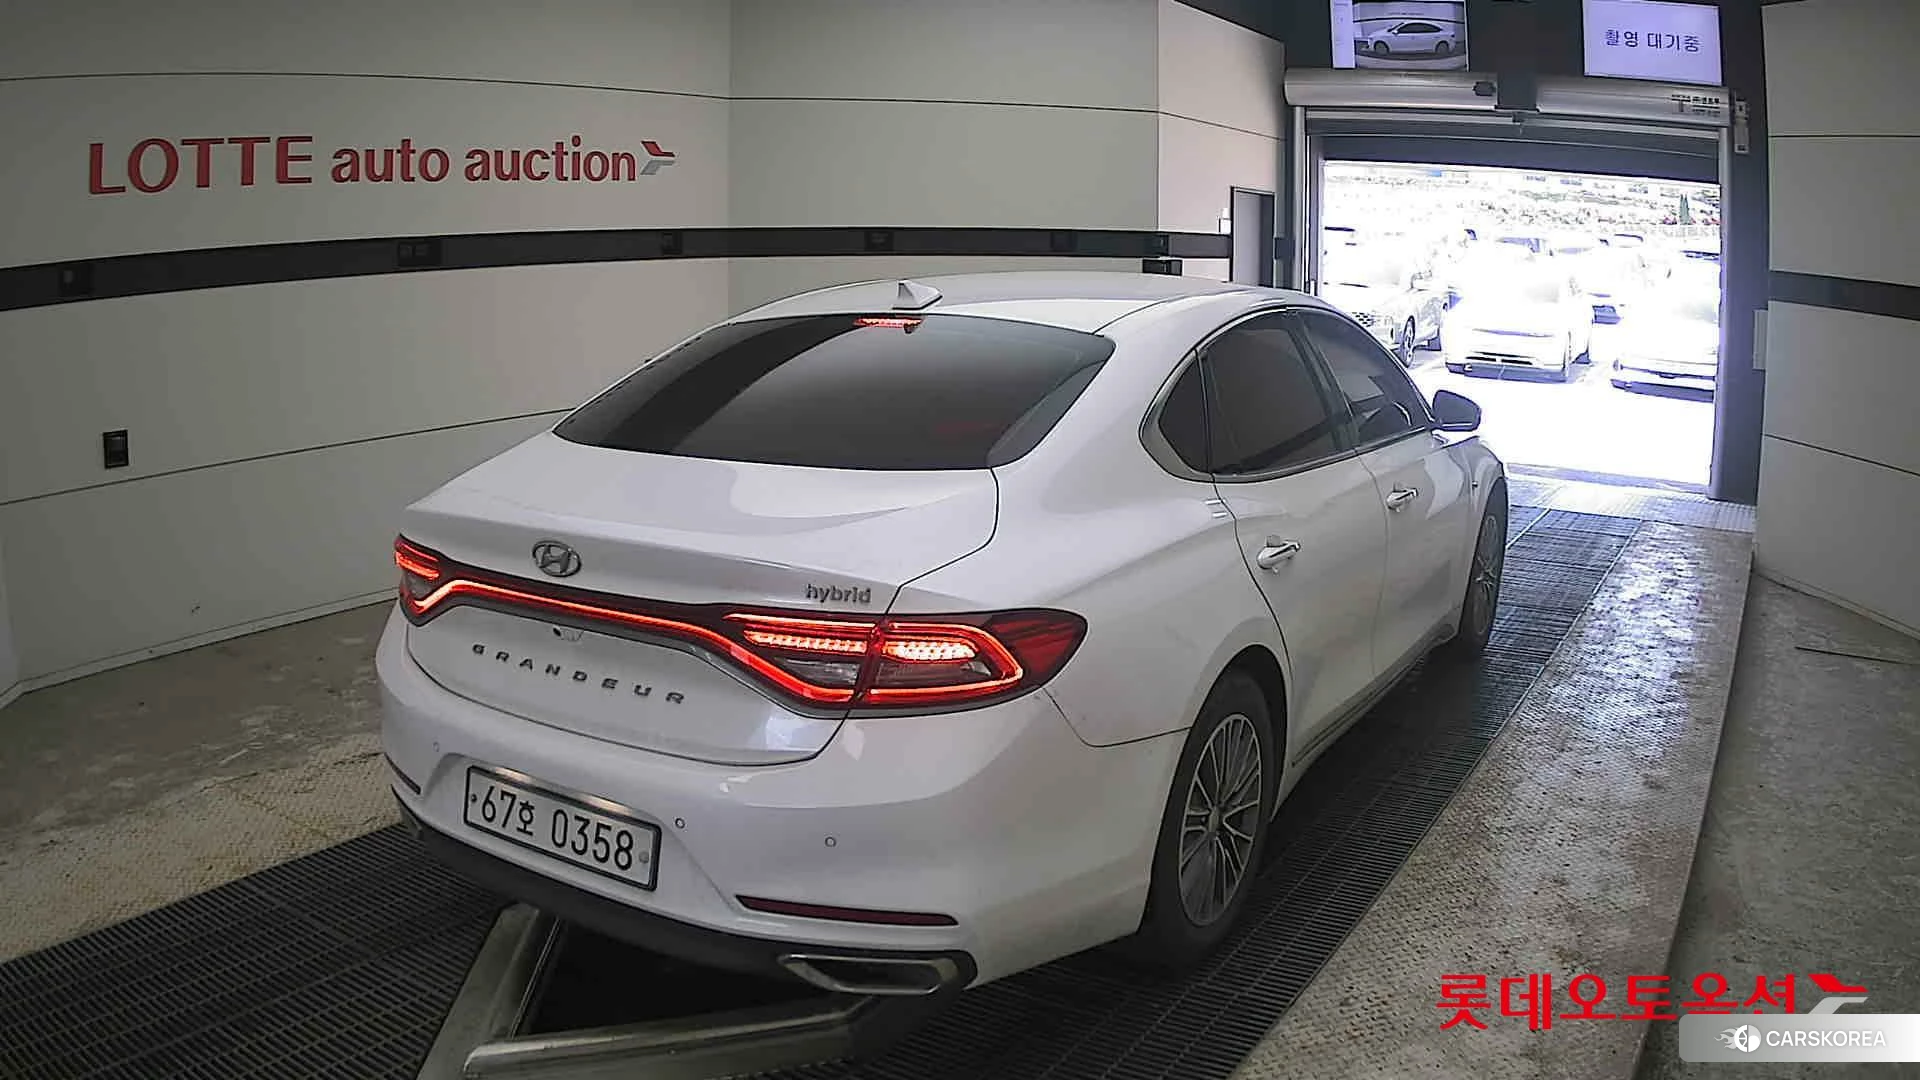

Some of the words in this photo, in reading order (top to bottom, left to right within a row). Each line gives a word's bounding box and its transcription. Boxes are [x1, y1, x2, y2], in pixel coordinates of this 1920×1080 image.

[1605, 29, 1639, 48] 촬영
[1646, 32, 1699, 53] 대기중
[89, 135, 313, 195] LOTTE
[331, 138, 450, 184] auto
[464, 135, 637, 184] auction
[805, 583, 871, 606] hybrid
[471, 643, 685, 706] GRANDEUR
[481, 785, 535, 837] 67호
[551, 808, 634, 871] 0358
